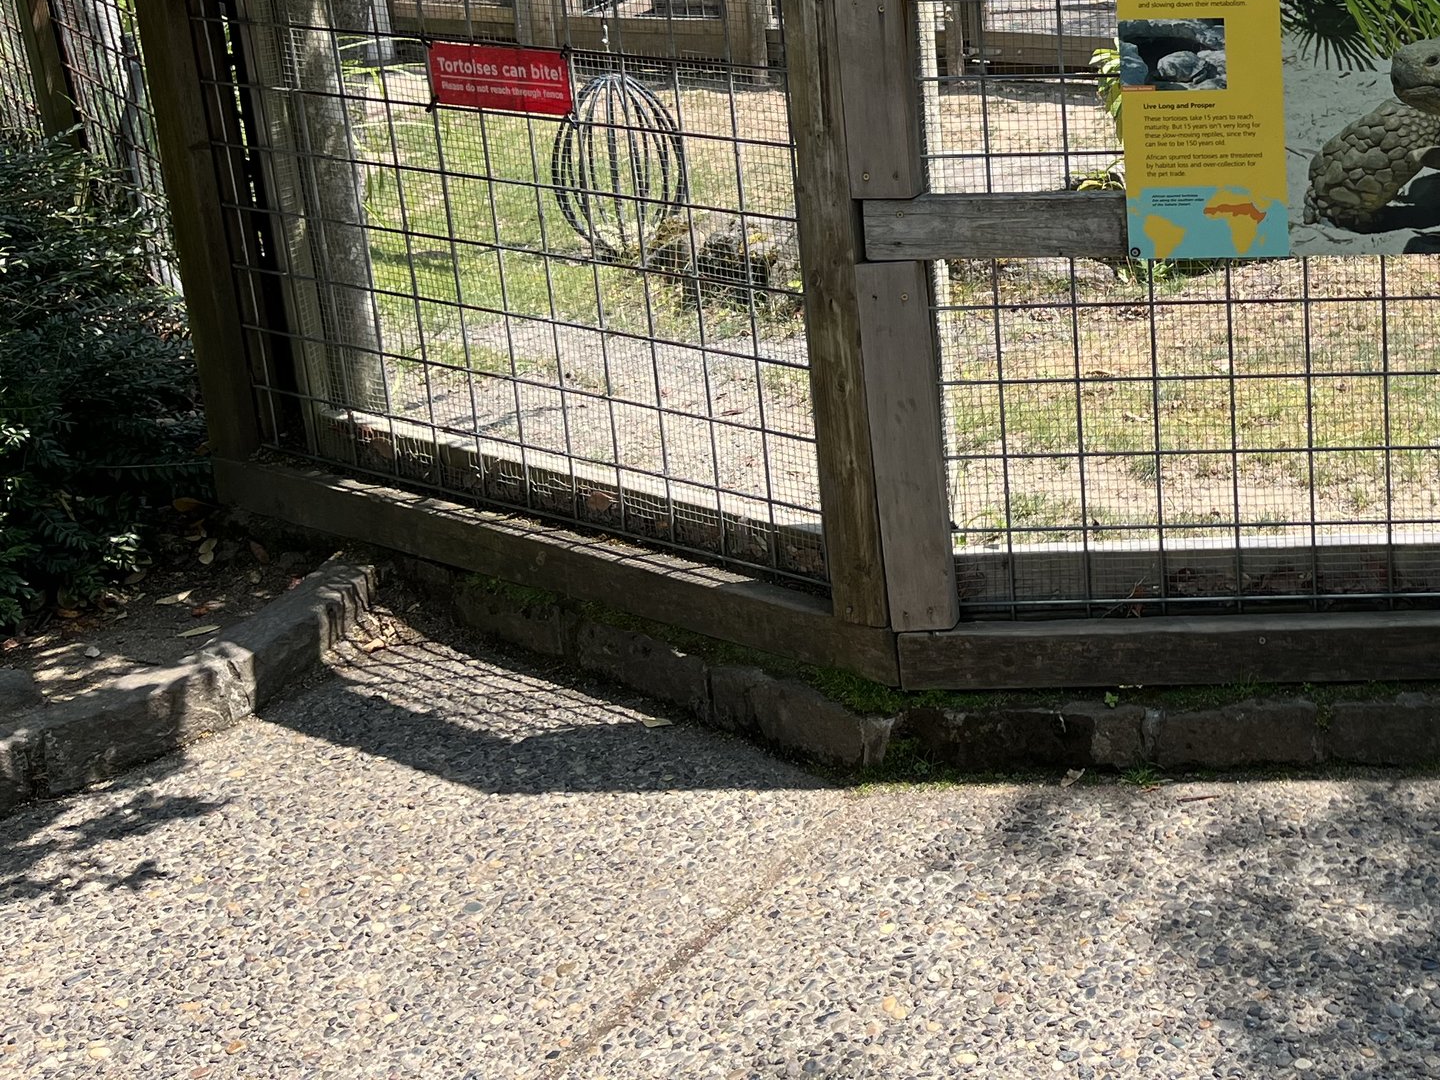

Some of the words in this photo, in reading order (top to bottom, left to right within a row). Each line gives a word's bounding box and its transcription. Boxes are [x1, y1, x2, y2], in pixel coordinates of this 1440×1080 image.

[437, 57, 498, 75] Tortoises
[502, 65, 526, 78] can
[531, 64, 563, 81] bite!
[442, 81, 464, 90] Please
[466, 83, 475, 92] do
[477, 85, 489, 93] not
[491, 86, 510, 95] reach
[512, 88, 542, 98] through
